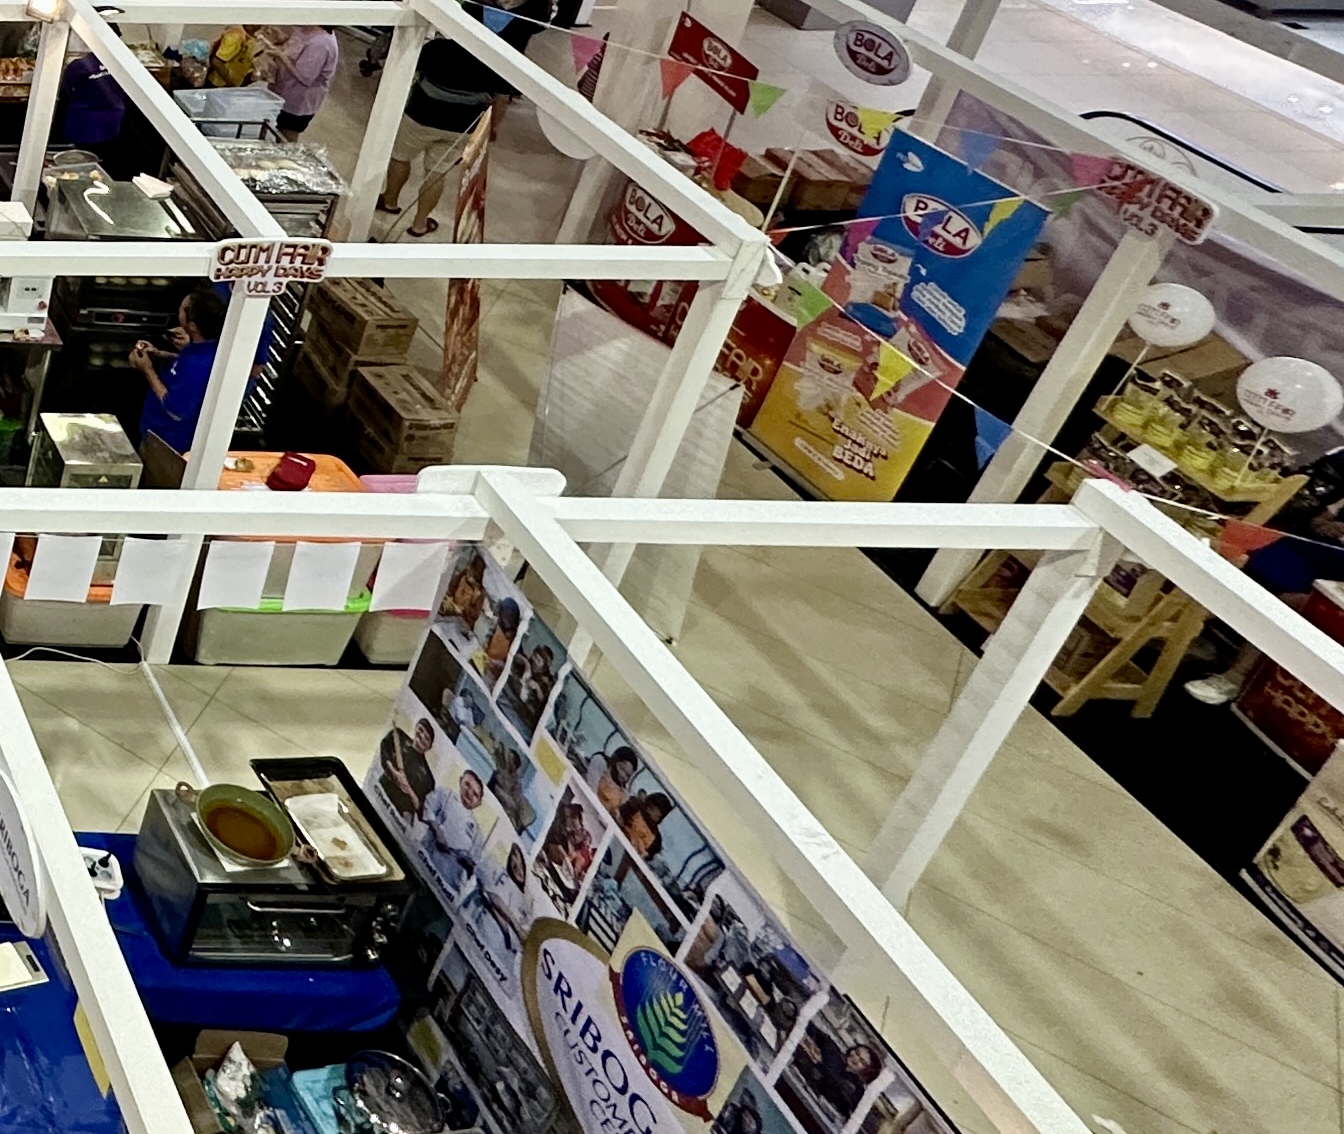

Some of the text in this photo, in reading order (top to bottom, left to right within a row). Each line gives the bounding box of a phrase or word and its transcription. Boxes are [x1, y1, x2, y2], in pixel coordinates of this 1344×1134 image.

[853, 31, 895, 63] BOLA
[838, 129, 865, 151] Deli
[628, 187, 666, 232] BOLA
[914, 199, 971, 246] BLA
[217, 242, 330, 267] CLTM FAIR
[214, 266, 324, 281] HAPPY DAYS
[832, 417, 889, 459] Enaknya
[843, 438, 873, 460] Jadi
[832, 446, 875, 481] BEDA
[541, 947, 659, 1134] SRIBOG
[554, 1010, 636, 1134] CUSTOM
